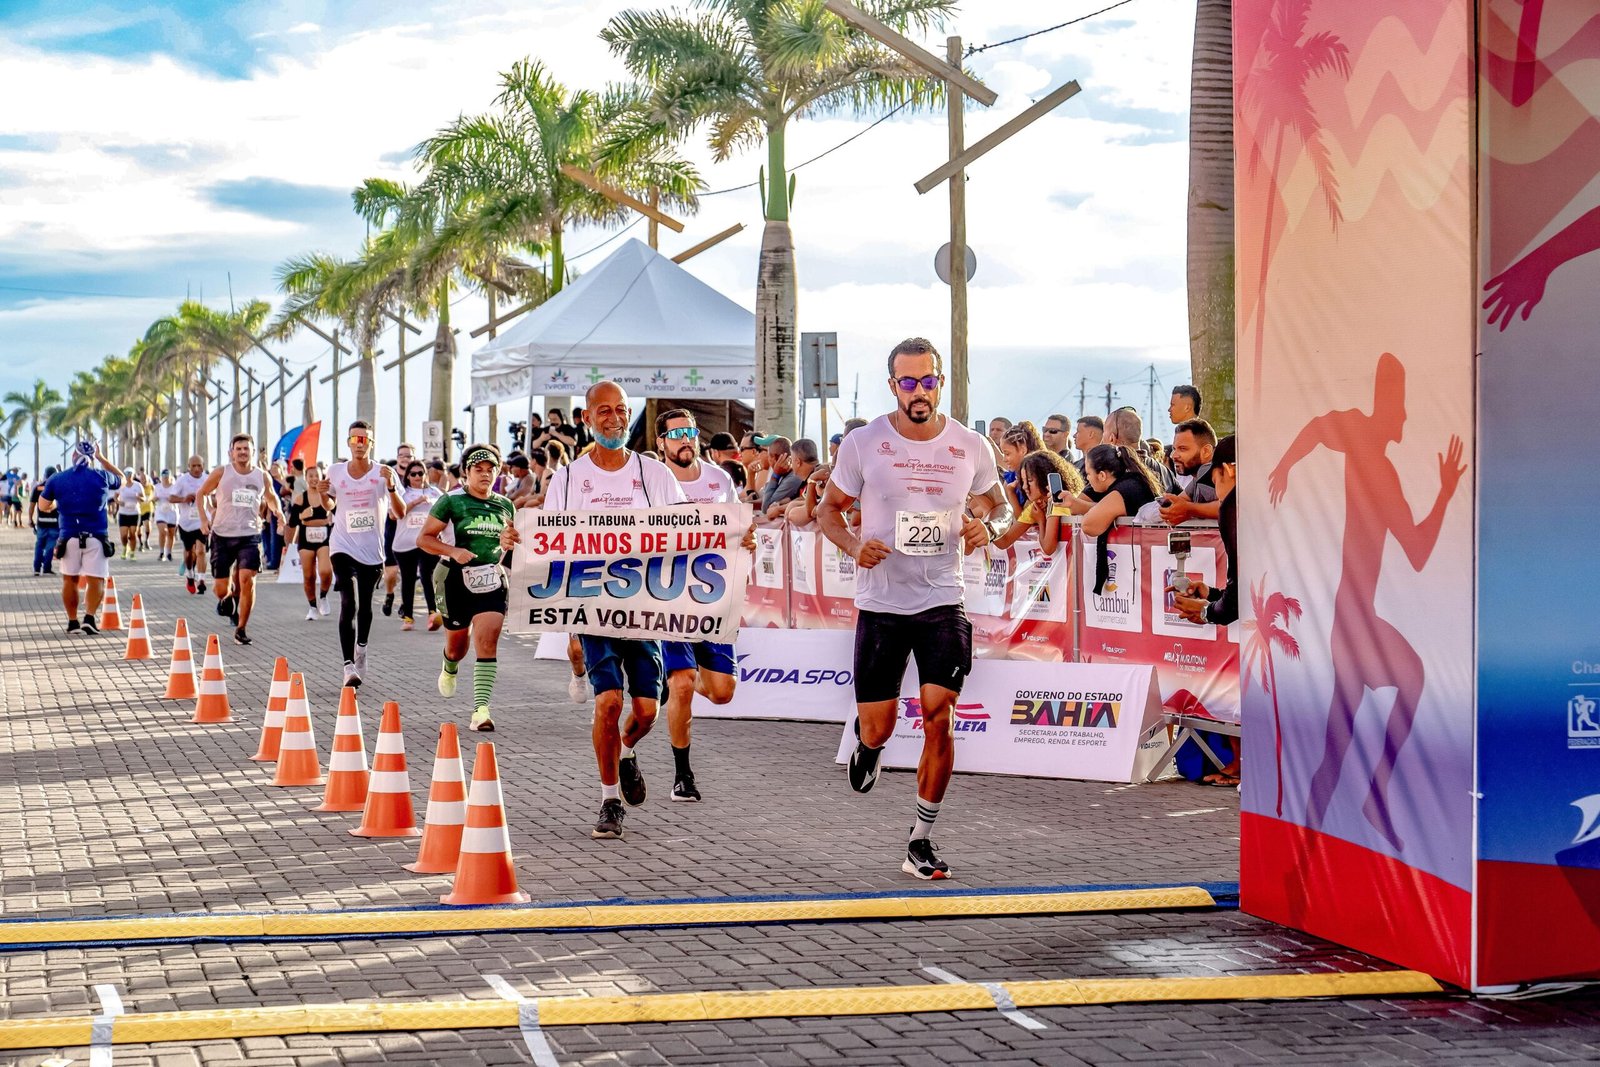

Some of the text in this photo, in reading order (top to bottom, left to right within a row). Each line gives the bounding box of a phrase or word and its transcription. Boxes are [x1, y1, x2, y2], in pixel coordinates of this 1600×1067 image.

[429, 428, 435, 436] E
[350, 516, 375, 527] 2683
[538, 513, 576, 526] ILHÉUS
[589, 515, 636, 526] ITABUNA
[713, 514, 727, 525] BA
[908, 526, 941, 543] 220
[533, 532, 726, 555] 34 ANOS DE LUTA
[990, 558, 1006, 573] PORTO
[470, 573, 495, 586] 2277
[527, 553, 727, 604] JESUS
[985, 573, 1006, 588] SEGURO
[1093, 592, 1130, 614] Cambuí
[529, 604, 722, 635] ESTÁ VOLTANDO!
[740, 668, 854, 686] VIDASPO
[1016, 690, 1123, 702] GOVERNO DO ESTADO
[1010, 700, 1119, 728] BAHIA
